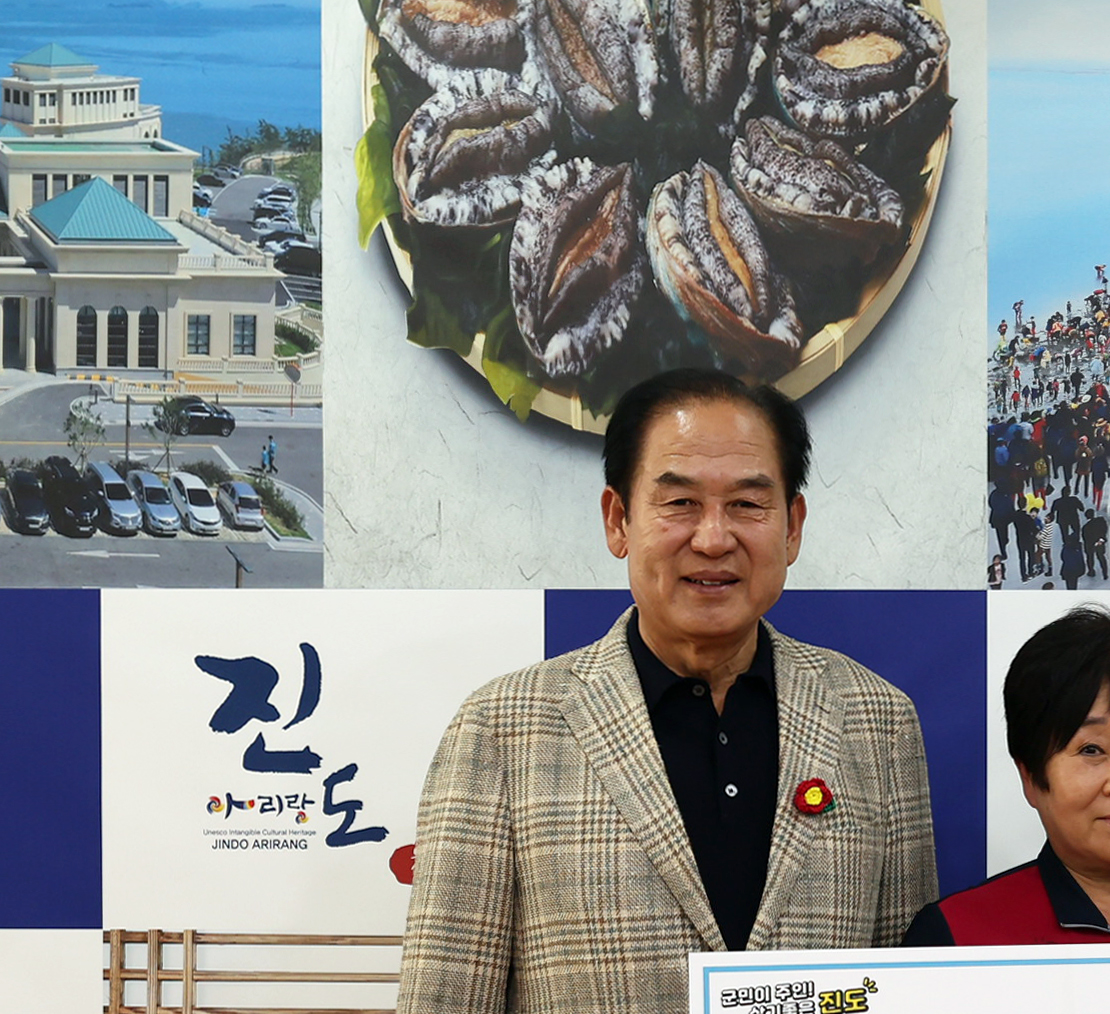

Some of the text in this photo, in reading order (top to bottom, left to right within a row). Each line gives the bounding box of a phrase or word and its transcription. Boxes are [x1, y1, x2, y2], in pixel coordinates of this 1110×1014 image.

[206, 792, 316, 825] 아리랑
[229, 829, 261, 838] Intangible
[289, 829, 317, 838] Heritage
[212, 839, 308, 850] JINDO ARIRANG
[721, 981, 815, 1008] 군민이 주인!
